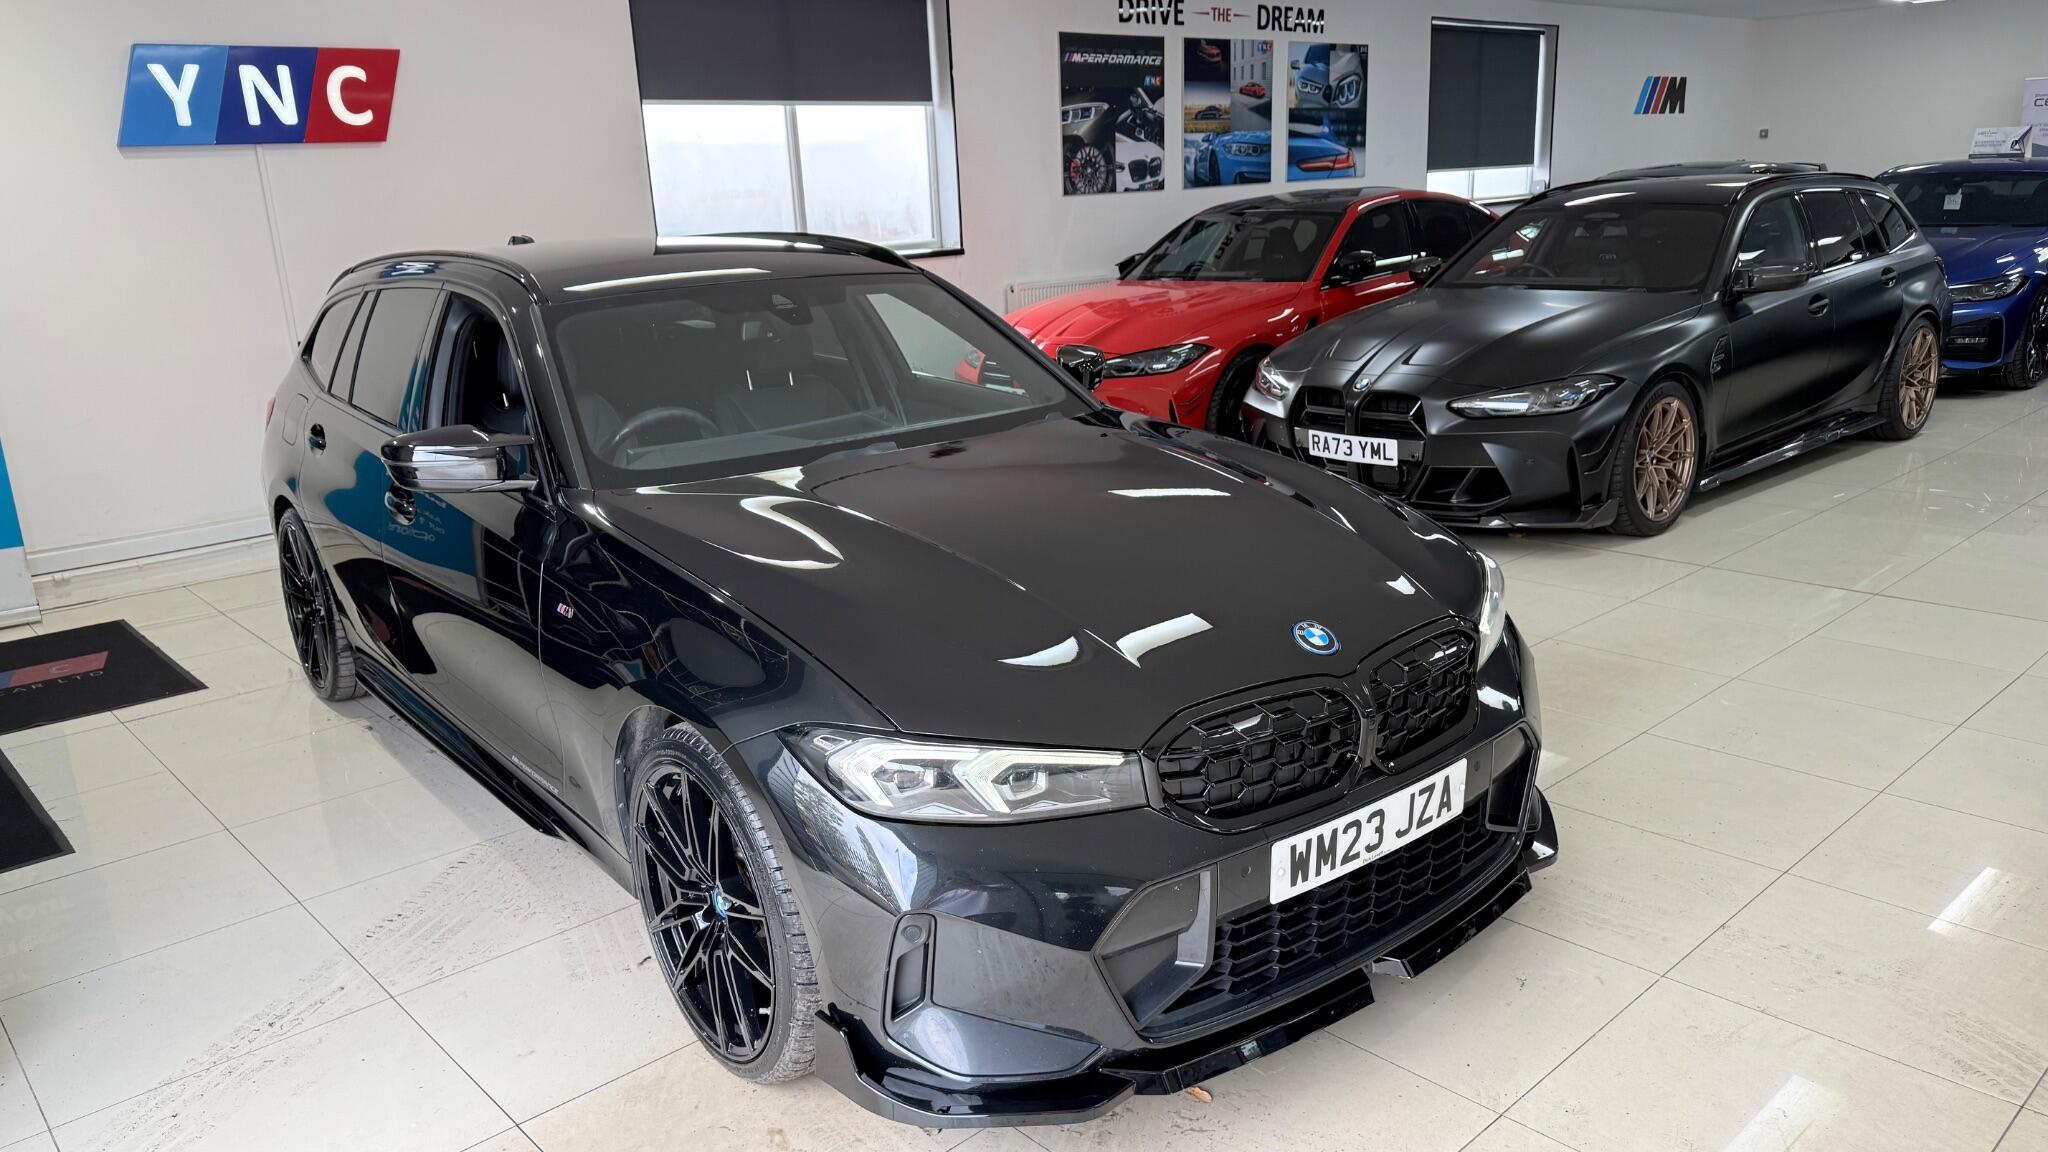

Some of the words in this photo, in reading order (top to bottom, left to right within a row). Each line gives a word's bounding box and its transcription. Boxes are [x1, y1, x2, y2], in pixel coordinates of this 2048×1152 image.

[1118, 0, 1185, 26] DRIVE
[1211, 7, 1232, 23] THE
[1257, 4, 1325, 35] DREAM
[147, 63, 374, 127] YNC
[1311, 434, 1353, 457] RA73
[1358, 440, 1394, 461] YML
[1289, 808, 1386, 888] WM23
[1395, 774, 1453, 840] JZA
